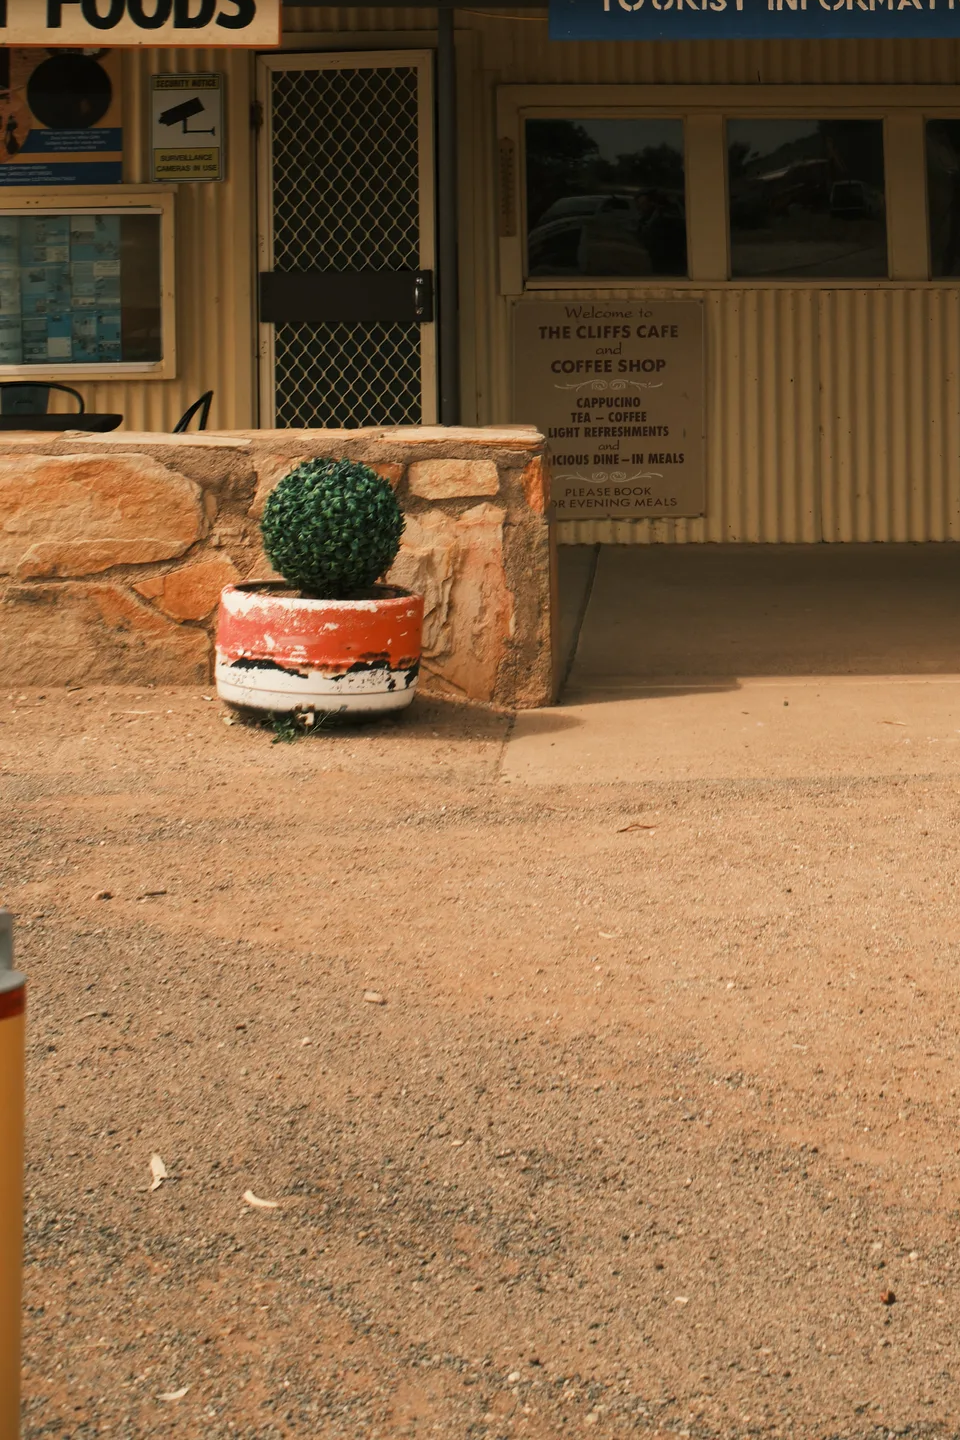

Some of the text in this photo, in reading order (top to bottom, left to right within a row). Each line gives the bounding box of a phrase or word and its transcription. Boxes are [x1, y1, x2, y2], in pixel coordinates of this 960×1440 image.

[156, 79, 217, 88] SECURITY NOTICE
[160, 154, 213, 162] SURVEILLANCE
[565, 306, 653, 319] Welcome to
[539, 324, 679, 339] THE CLIFFS CAFE
[595, 342, 622, 355] and
[551, 359, 666, 374] COFFEE SHOP
[576, 397, 641, 408] CAPPUCINO
[571, 412, 591, 423] TEA
[608, 411, 647, 422] COFFEE
[548, 426, 669, 438] LIGHT REFRESHMENTS
[598, 440, 620, 451] and
[552, 454, 589, 466] ICIOUS
[647, 452, 685, 464] MEALS
[565, 486, 652, 497] PLEASE BOOK
[569, 498, 631, 508] EVENING
[634, 497, 678, 507] MEALS
